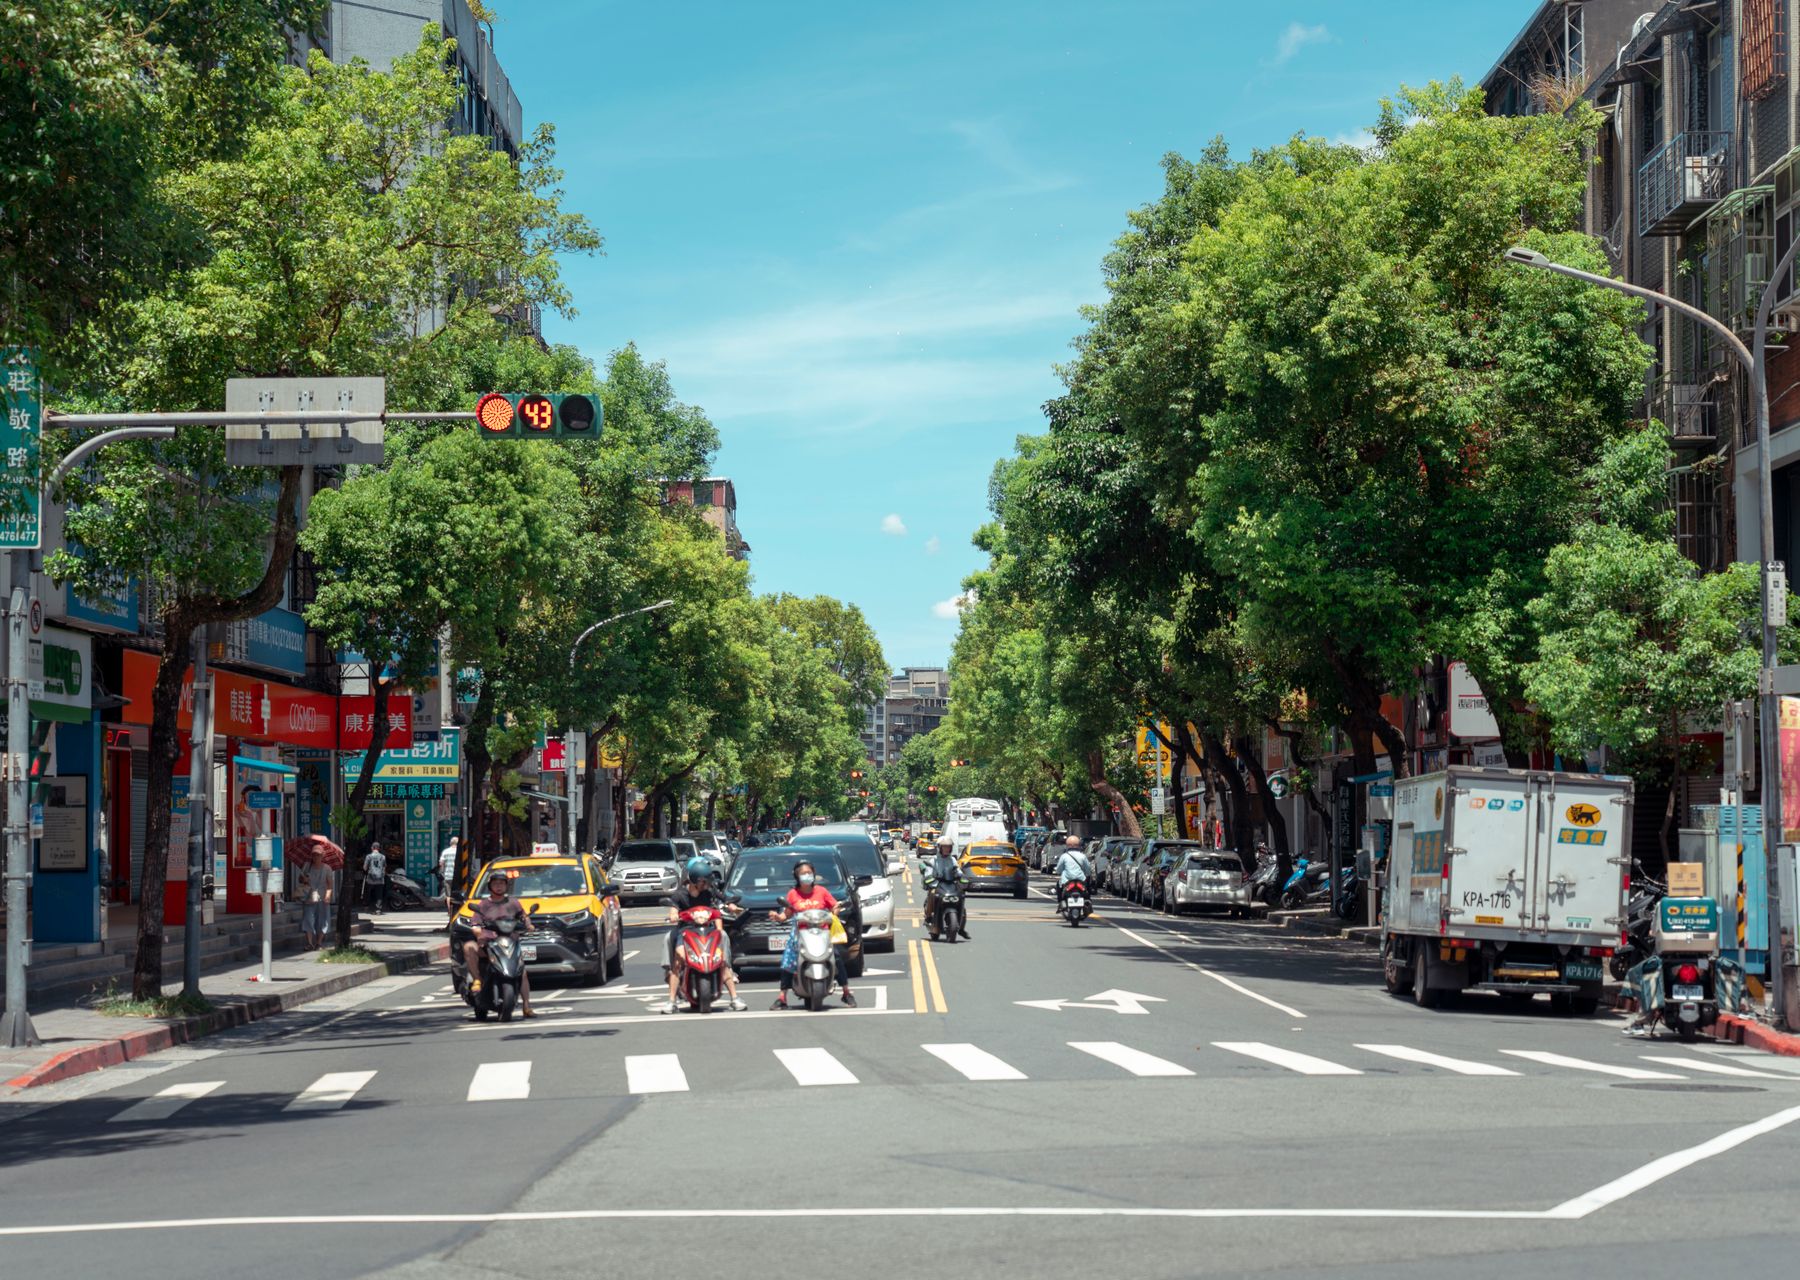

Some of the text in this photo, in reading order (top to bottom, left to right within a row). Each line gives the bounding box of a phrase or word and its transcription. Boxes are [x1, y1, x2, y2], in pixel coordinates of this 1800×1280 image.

[8, 370, 31, 467] 莊敬路
[525, 401, 552, 428] 43
[230, 688, 252, 724] 康是美
[289, 703, 316, 733] COSMED
[1463, 890, 1512, 909] KPA-1716
